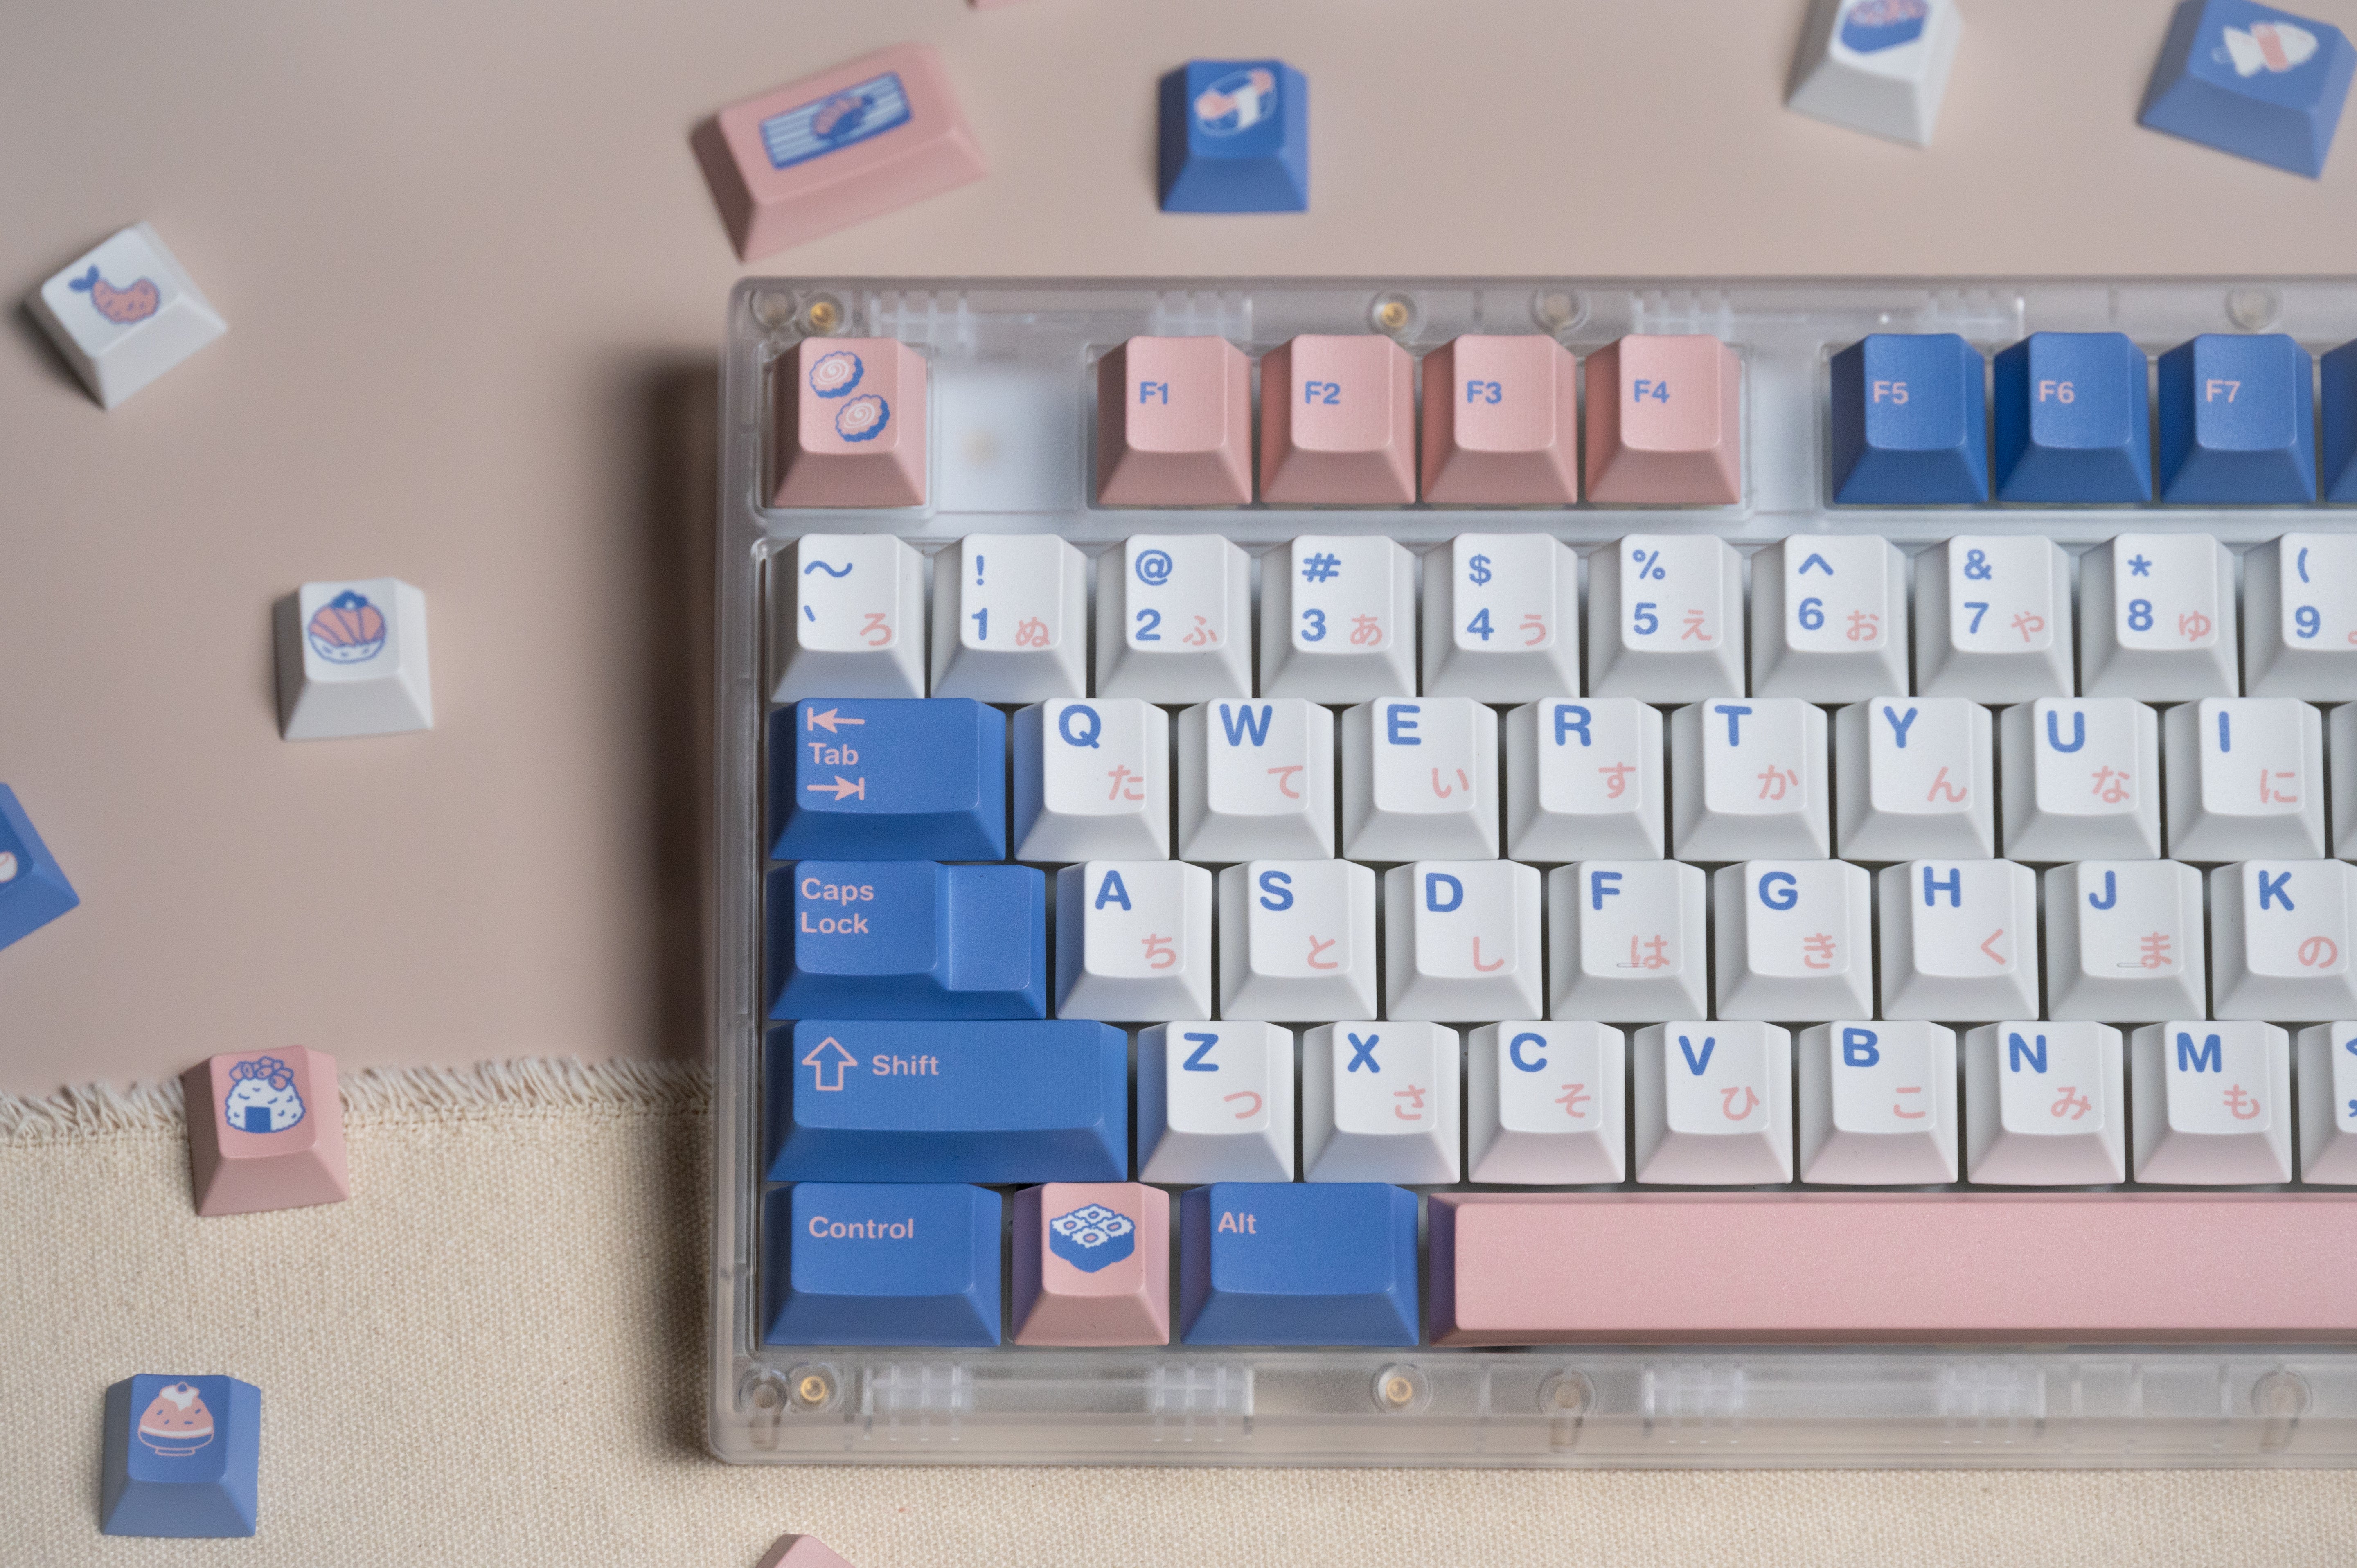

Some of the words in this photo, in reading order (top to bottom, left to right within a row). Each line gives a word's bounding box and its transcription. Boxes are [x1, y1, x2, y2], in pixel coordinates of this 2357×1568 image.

[1140, 381, 1168, 404] F1
[1305, 381, 1341, 405] F2
[1467, 381, 1502, 404] F3
[1634, 380, 1669, 403] F4
[1873, 381, 1908, 404] F5
[2039, 380, 2074, 403] F6
[2206, 379, 2240, 402] F7
[976, 555, 984, 585] !
[1136, 550, 1173, 586] @
[1302, 553, 1341, 582] #
[1469, 554, 1492, 586] $
[1633, 550, 1665, 580] %
[1964, 549, 1991, 580] &
[2298, 548, 2309, 583] (
[860, 613, 892, 646] ろ
[972, 608, 987, 640] 1
[1136, 609, 1161, 640] 2
[1183, 615, 1217, 646] ふ
[1302, 609, 1326, 641] 3
[1350, 614, 1383, 646] あ
[1467, 608, 1494, 640] 4
[1520, 614, 1546, 646] う
[1634, 602, 1658, 635] 5
[1682, 609, 1712, 641] え
[1799, 598, 1824, 630] 6
[1846, 610, 1879, 641] お
[1964, 602, 1989, 633] 7
[2011, 611, 2045, 642] や
[2128, 599, 2153, 631] 8
[2179, 611, 2211, 642] ゆ
[2295, 606, 2320, 638] 9
[1016, 617, 1050, 647] ぬ
[1059, 705, 1101, 749] Q
[1220, 704, 1272, 746] W
[1387, 704, 1421, 745] E
[1555, 705, 1591, 746] R
[1715, 705, 1752, 746] T
[1884, 706, 1918, 748] Y
[2047, 711, 2085, 753] U
[2219, 712, 2230, 752] I
[809, 743, 858, 765] Tab
[1108, 765, 1144, 800] た
[1268, 765, 1303, 799] て
[1432, 768, 1469, 798] い
[1599, 762, 1636, 798] す
[1758, 765, 1798, 800] か
[1927, 767, 1967, 802] ん
[2092, 766, 2130, 803] な
[2260, 769, 2297, 803] に
[801, 878, 873, 905] Caps
[1095, 870, 1131, 911] A
[1260, 871, 1293, 911] S
[1426, 873, 1463, 912] D
[1591, 871, 1622, 910] F
[1759, 872, 1798, 910] G
[1924, 867, 1960, 907] H
[2089, 871, 2116, 910] J
[2259, 870, 2294, 911] K
[801, 912, 868, 933] Lock
[1142, 934, 1176, 969] ち
[1307, 936, 1338, 969] と
[1473, 937, 1504, 972] し
[1631, 935, 1670, 969] は
[1804, 933, 1836, 969] き
[1981, 929, 2005, 964] く
[2141, 932, 2172, 969] ま
[2298, 936, 2338, 968] の
[1183, 1033, 1219, 1072] Z
[1348, 1033, 1380, 1073] X
[1510, 1033, 1547, 1072] C
[1679, 1036, 1715, 1075] V
[1843, 1028, 1879, 1067] B
[2009, 1033, 2047, 1073] N
[2177, 1033, 2222, 1072] M
[873, 1055, 938, 1075] Shift
[1224, 1091, 1262, 1119] つ
[1394, 1085, 1425, 1120] さ
[1555, 1083, 1591, 1118] そ
[1721, 1086, 1759, 1121] ひ
[1893, 1087, 1925, 1119] こ
[2051, 1086, 2091, 1120] み
[2224, 1084, 2260, 1120] も
[809, 1216, 913, 1239] Control
[1218, 1212, 1255, 1234] Alt
